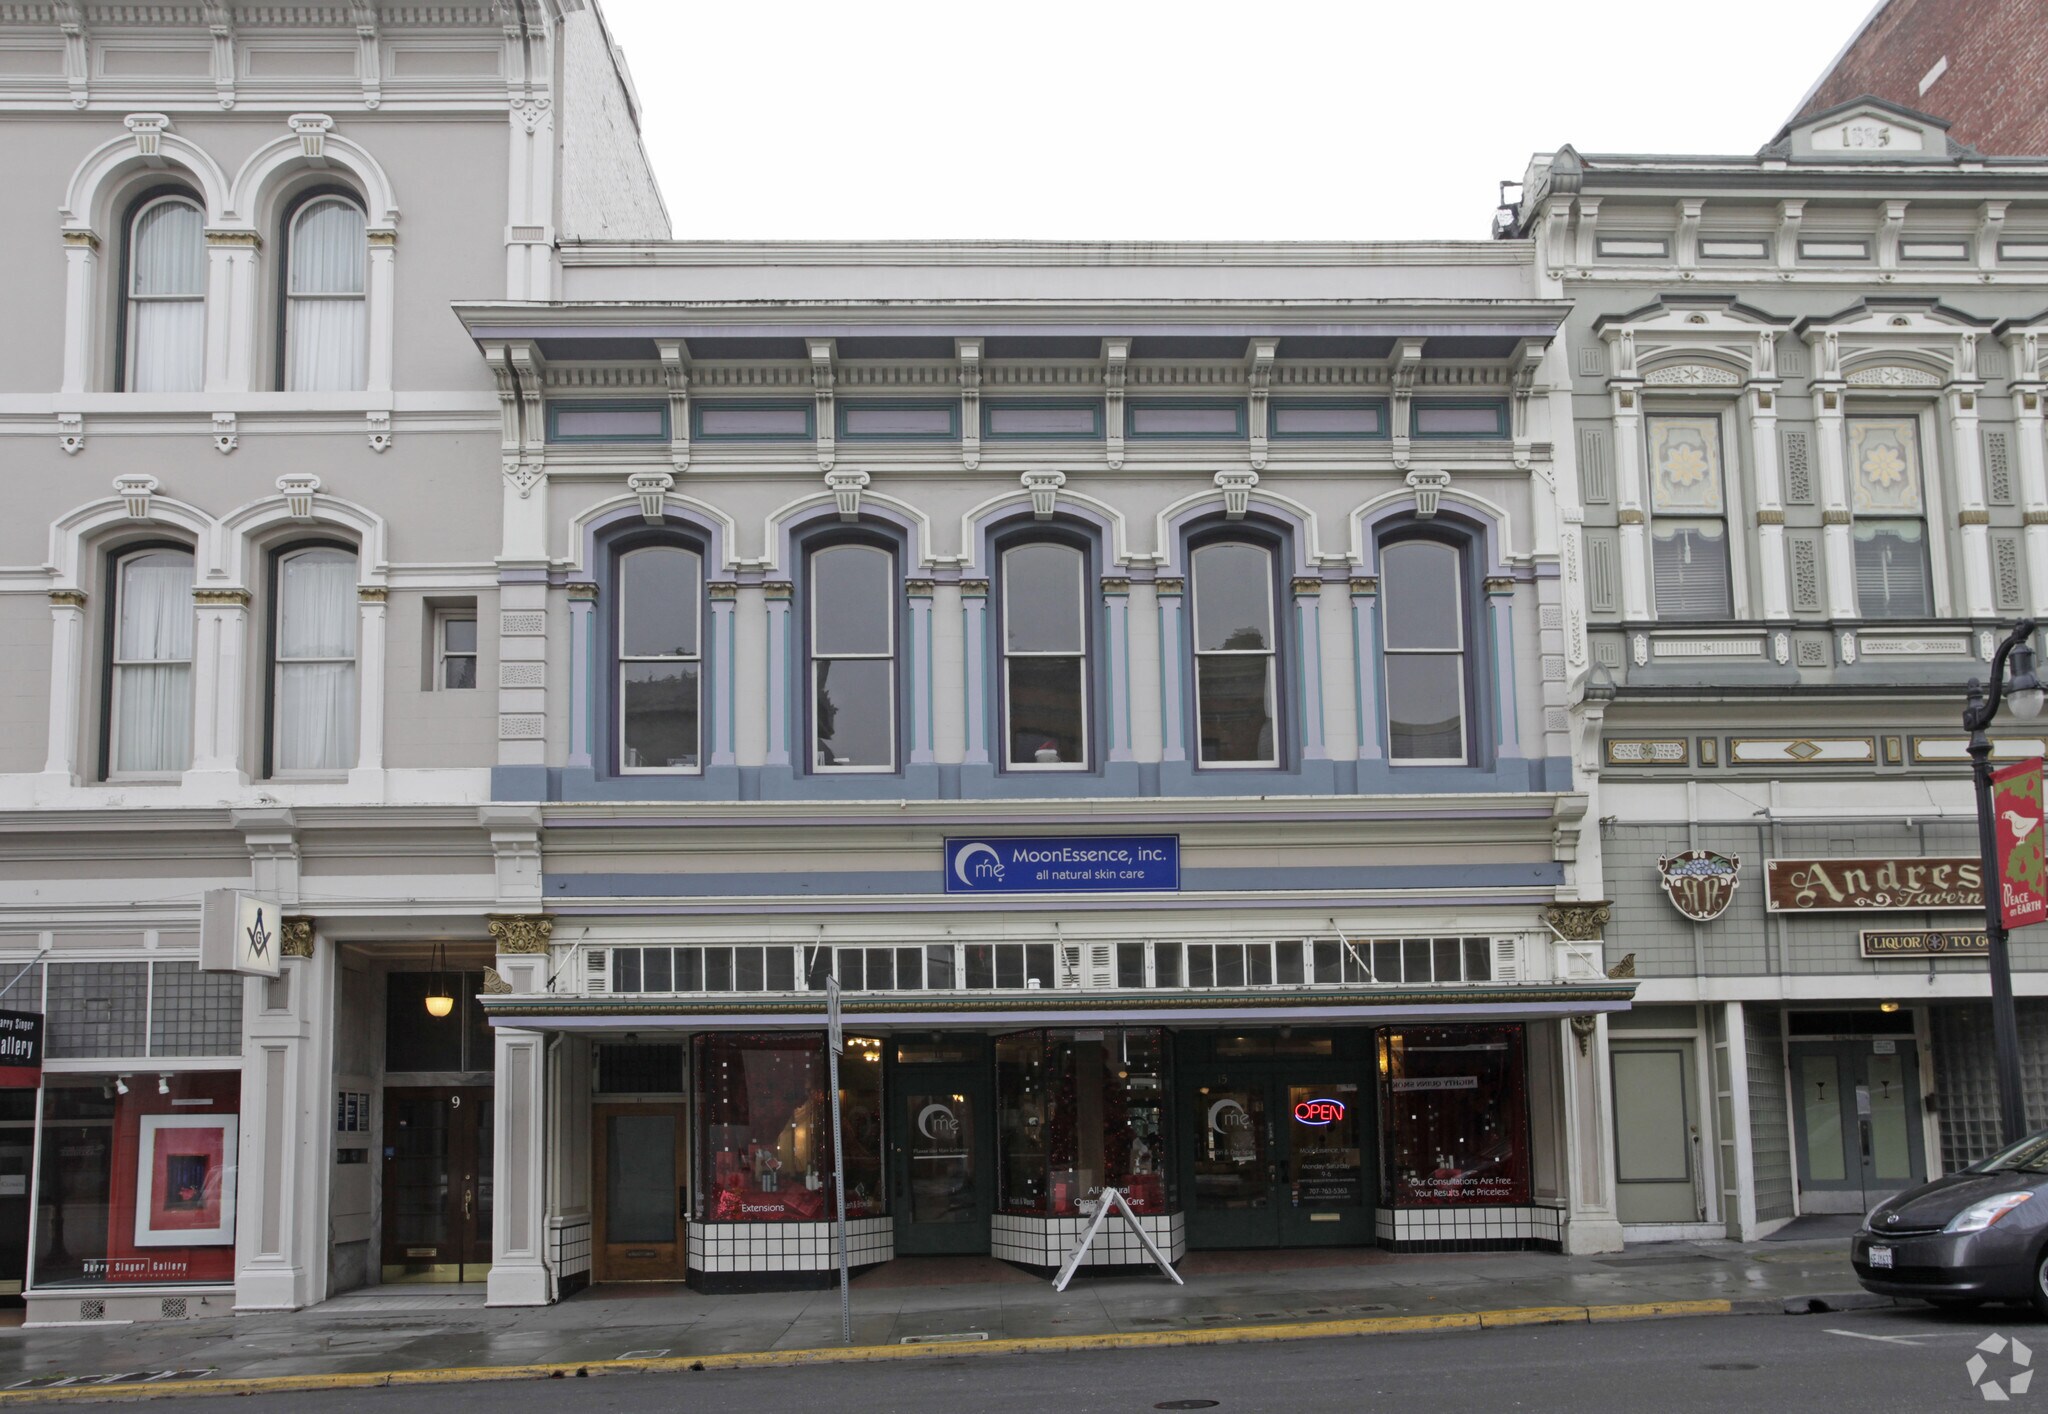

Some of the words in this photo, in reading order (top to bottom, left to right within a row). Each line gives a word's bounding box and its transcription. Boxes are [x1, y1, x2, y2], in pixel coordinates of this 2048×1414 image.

[1013, 847, 1132, 864] MoonEssence,
[1138, 846, 1167, 861] inc.
[1036, 870, 1049, 880] all
[1052, 869, 1092, 880] natural
[1095, 868, 1117, 879] skin
[1119, 870, 1145, 879] care
[1791, 861, 1982, 908] Andres
[1895, 886, 1983, 907] Tavern
[2017, 900, 2041, 915] EARTH
[1874, 936, 1923, 950] LIQUOR
[1950, 936, 1971, 947] TO
[1975, 935, 1989, 947] G
[0, 1019, 14, 1031] arry
[15, 1018, 34, 1032] Singer
[1, 1036, 34, 1059] allery
[451, 1095, 461, 1109] 9
[1294, 1102, 1343, 1121] OPEN
[1427, 1176, 1478, 1186] Consultations
[1479, 1176, 1494, 1185] Are
[1414, 1189, 1432, 1198] Your
[1434, 1188, 1460, 1197] Results
[1461, 1188, 1475, 1196] Are
[741, 1203, 785, 1213] Extensions
[1126, 1197, 1145, 1206] Care
[83, 1263, 110, 1273] Barry
[115, 1262, 145, 1273] Singer
[153, 1261, 187, 1271] Gallery
